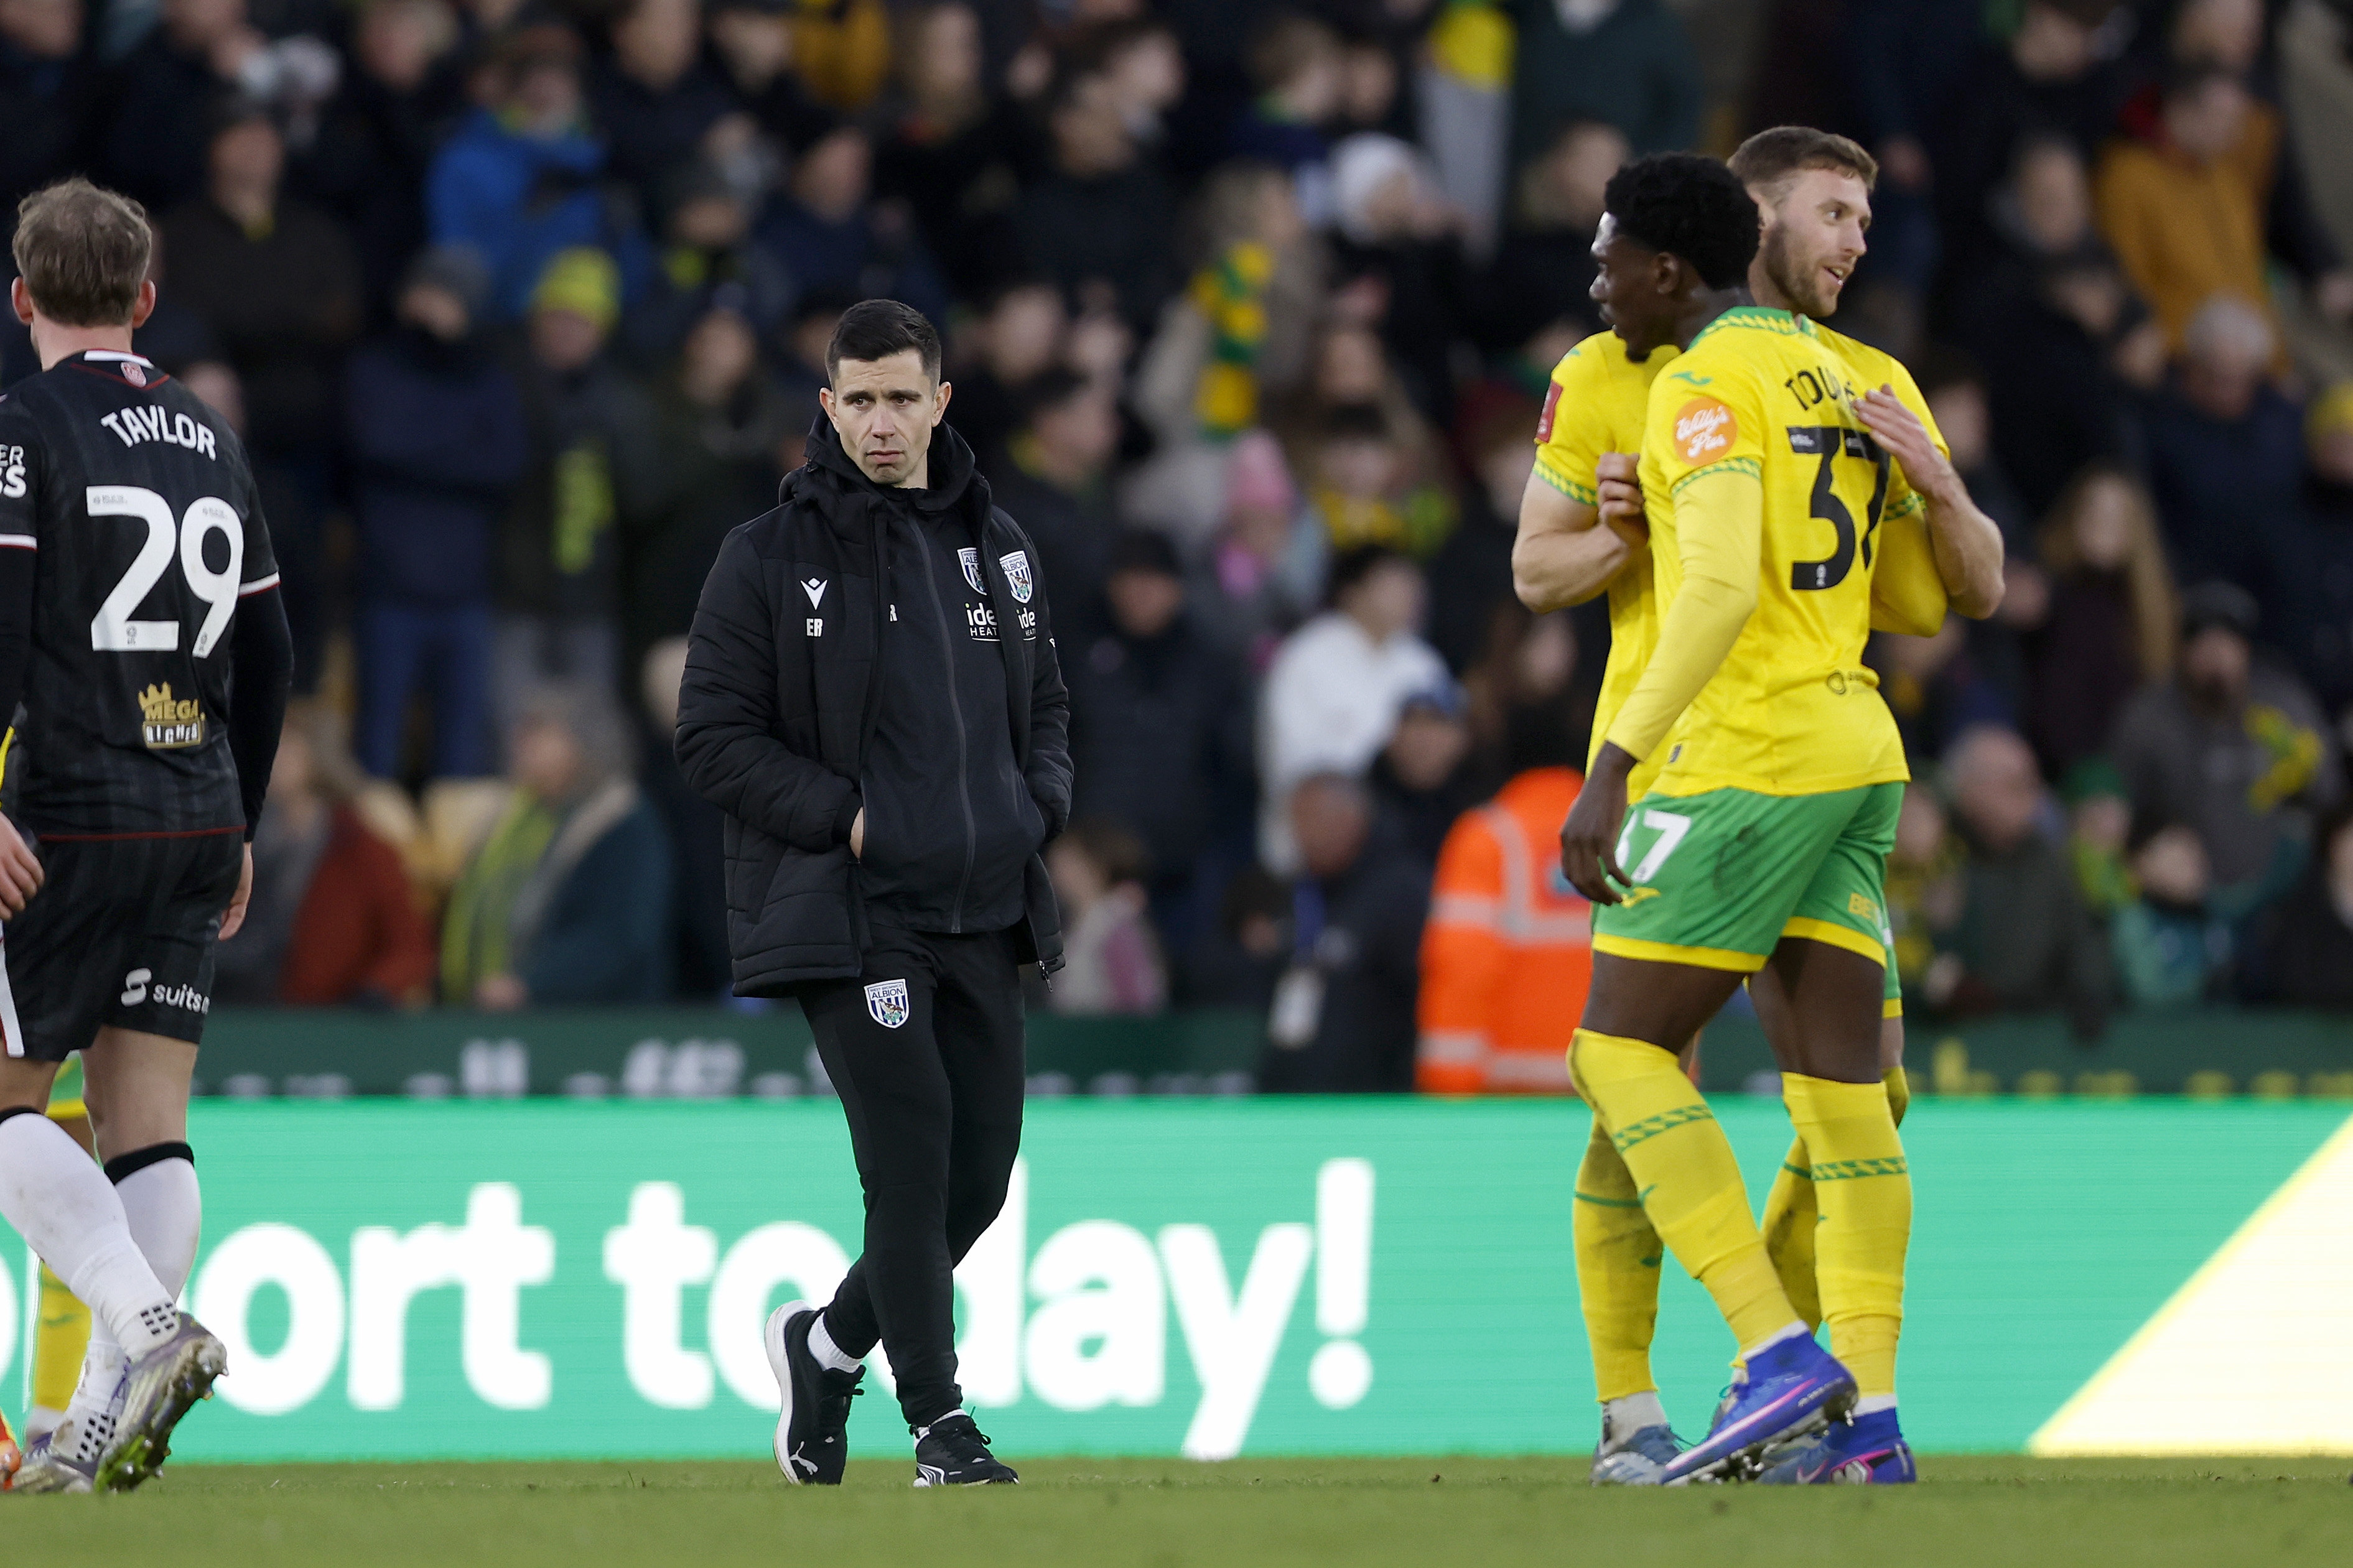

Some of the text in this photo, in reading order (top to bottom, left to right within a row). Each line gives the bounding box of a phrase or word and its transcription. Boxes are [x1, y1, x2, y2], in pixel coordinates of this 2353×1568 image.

[1785, 366, 1858, 418] TOU
[101, 405, 216, 461] TAYLOR
[0, 465, 27, 498] S
[1786, 427, 1890, 590] 37
[86, 485, 244, 659] 29
[1002, 559, 1025, 572] ALBION
[965, 603, 997, 626] ide
[1016, 607, 1035, 629] ide
[806, 618, 823, 637] ER
[970, 627, 997, 636] HEAT
[144, 698, 199, 721] MEGA
[872, 987, 903, 999] ALBION
[602, 1153, 1375, 1461] today!
